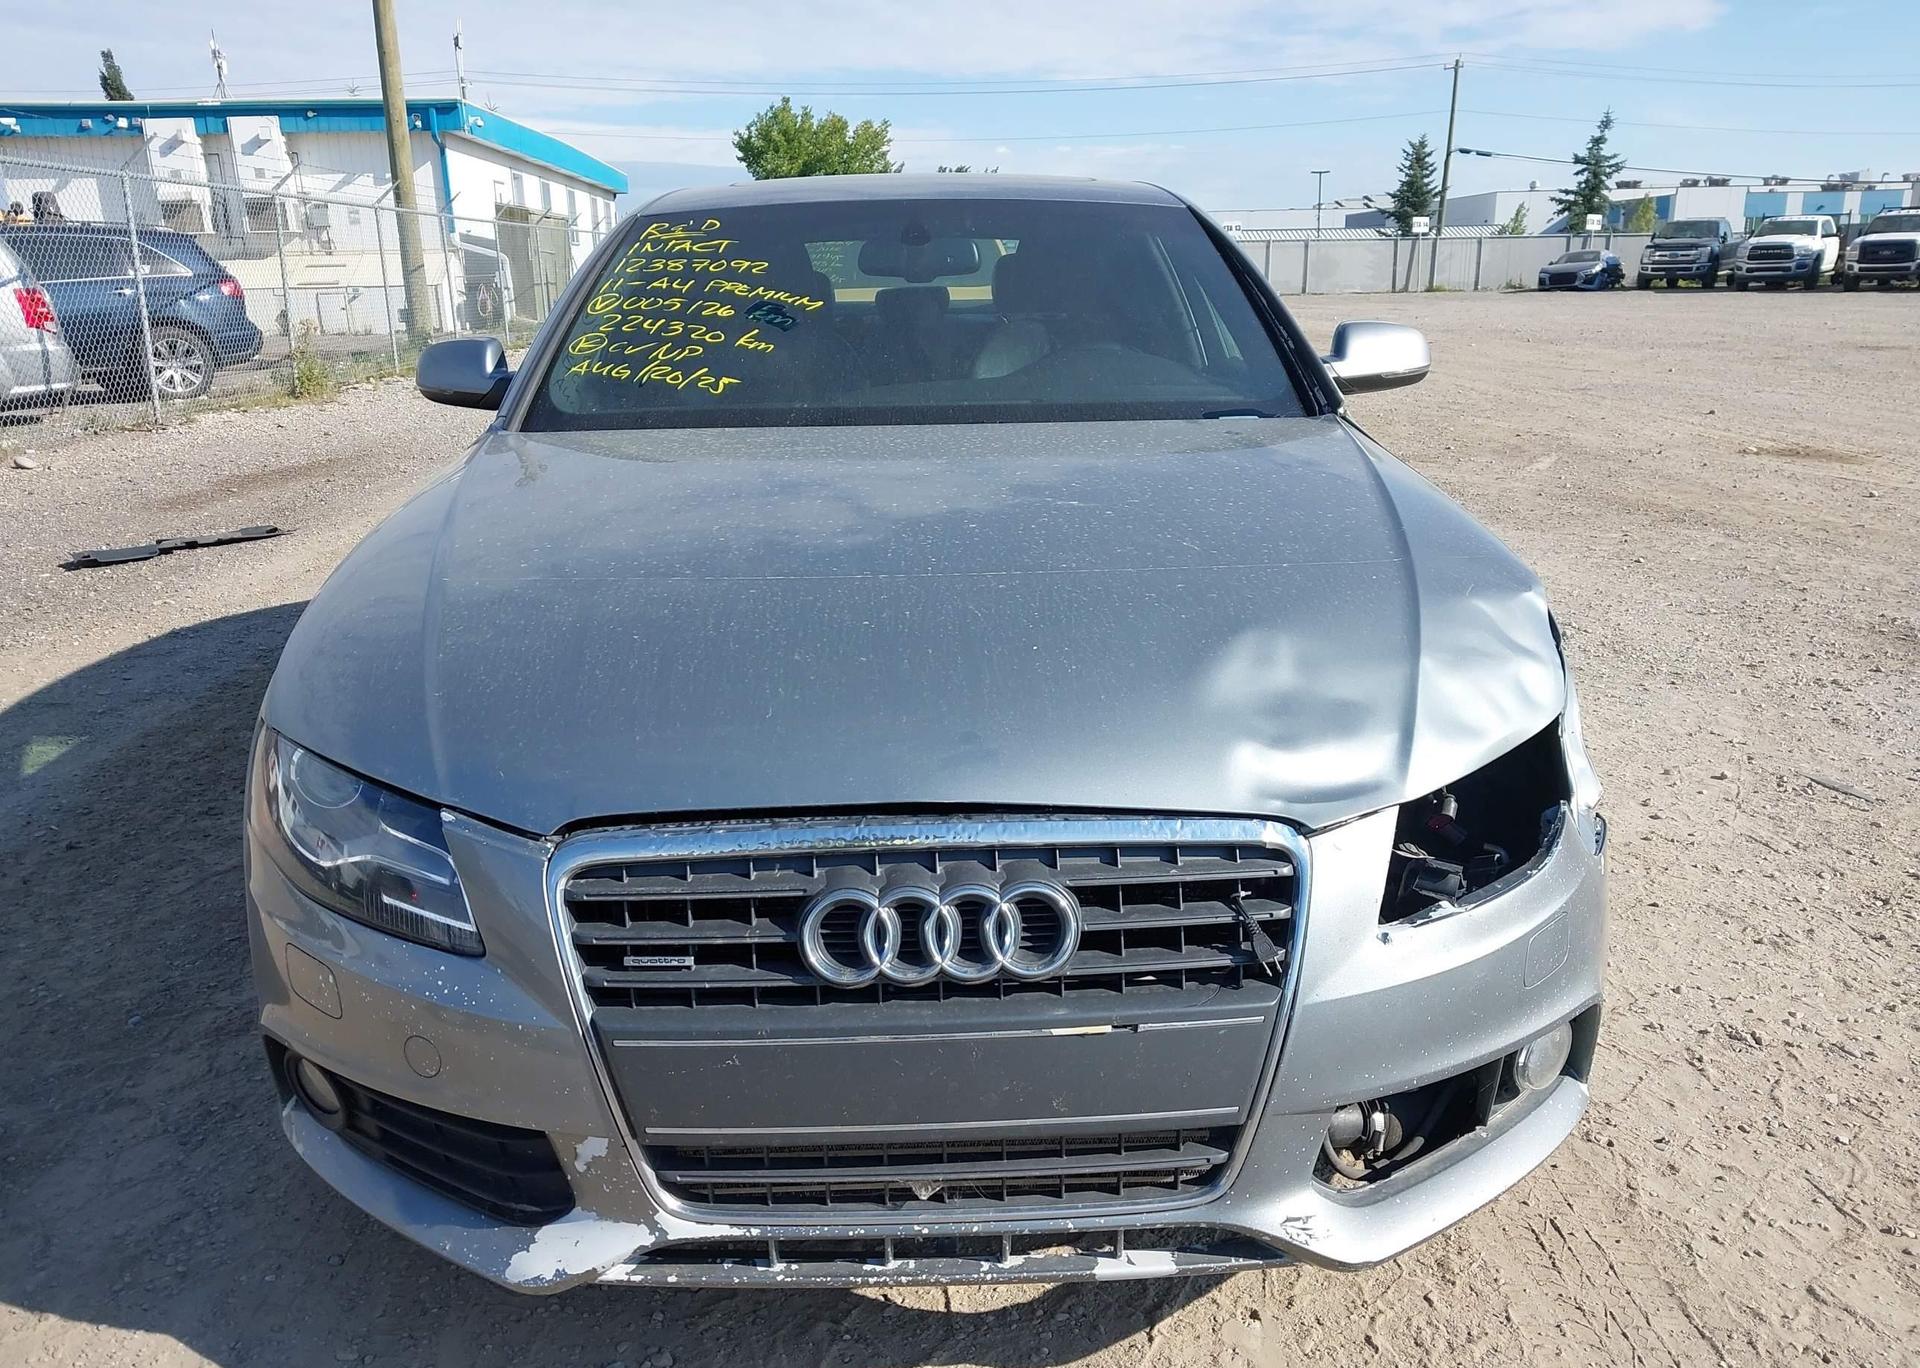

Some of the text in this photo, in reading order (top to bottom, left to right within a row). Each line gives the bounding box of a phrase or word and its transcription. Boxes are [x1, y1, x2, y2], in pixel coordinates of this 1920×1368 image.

[628, 239, 739, 254] INTACT
[615, 258, 768, 273] 12387092
[704, 279, 824, 311] PREMIUM
[599, 314, 725, 342] 224320
[734, 329, 775, 353] km
